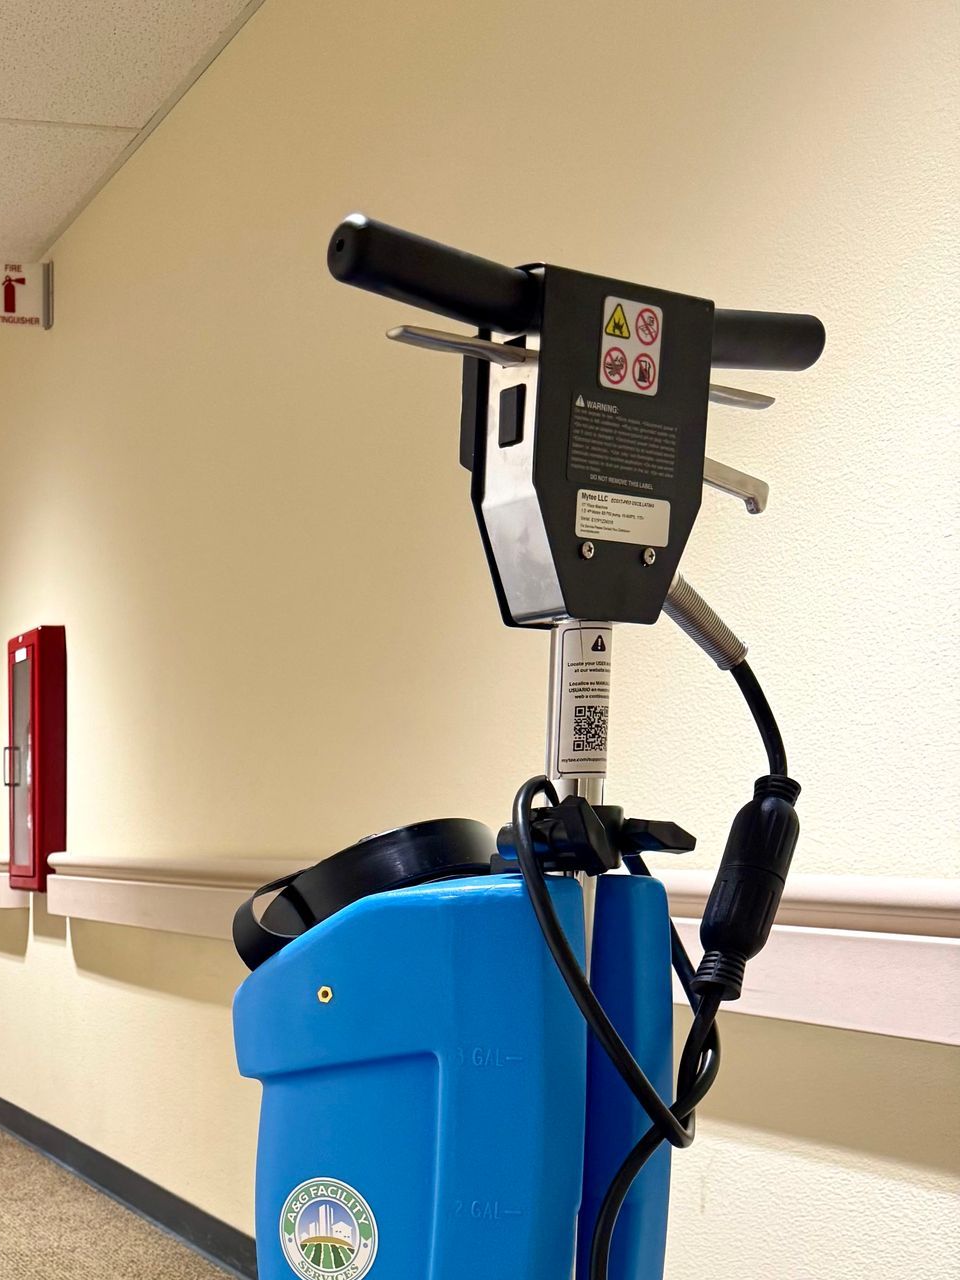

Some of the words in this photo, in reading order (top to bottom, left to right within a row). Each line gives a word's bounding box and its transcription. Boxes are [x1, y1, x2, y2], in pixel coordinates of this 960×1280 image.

[4, 264, 22, 273] FIRE
[586, 399, 619, 414] WARNING:
[597, 493, 609, 502] LLC
[472, 1047, 504, 1067] GAL
[287, 1192, 309, 1223] A&G
[309, 1185, 369, 1225] FACILITY
[470, 1200, 502, 1219] GAL
